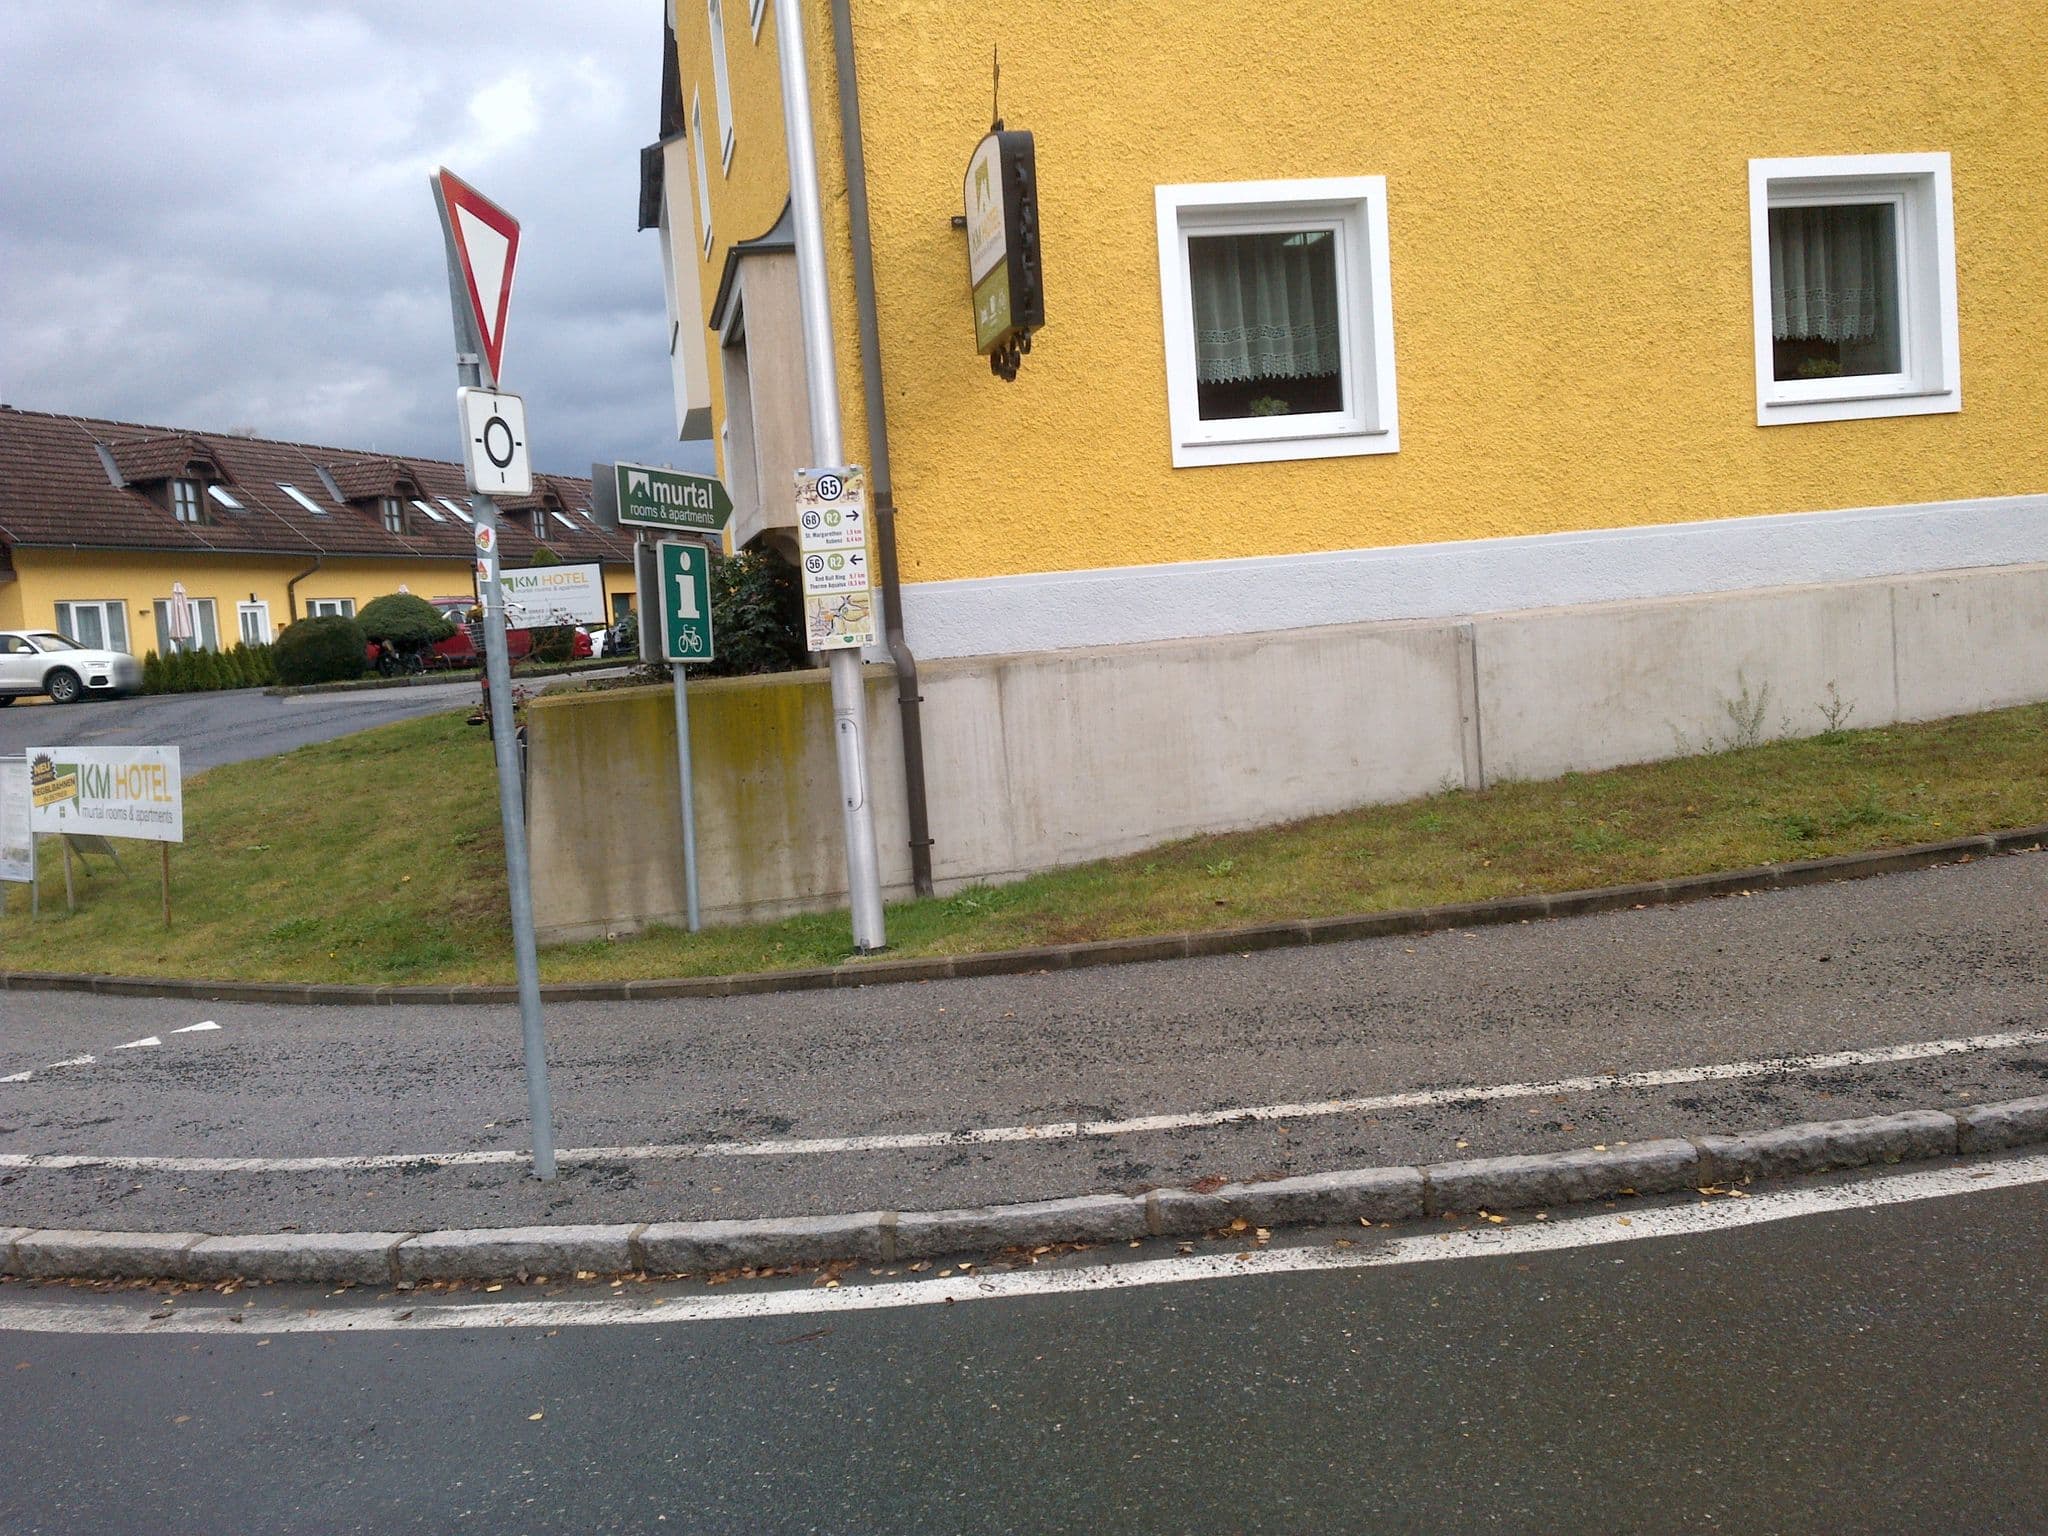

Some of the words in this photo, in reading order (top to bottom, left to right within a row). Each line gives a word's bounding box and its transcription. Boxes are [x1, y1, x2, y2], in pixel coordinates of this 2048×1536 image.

[652, 481, 714, 510] murtal
[821, 480, 838, 496] 65
[630, 504, 658, 518] rooms
[660, 505, 667, 519] &
[668, 508, 715, 525] apartments
[805, 514, 817, 526] 68
[826, 512, 839, 525] R2
[809, 558, 821, 570] 56
[829, 556, 843, 568] R2
[515, 575, 538, 588] KM
[541, 572, 589, 587] HOTEL
[34, 761, 51, 776] NEU
[81, 763, 111, 800] KM
[115, 763, 173, 802] HOTEL
[82, 803, 105, 820] murtal
[105, 806, 128, 822] rooms
[128, 805, 134, 821] &
[135, 808, 174, 826] apartments
